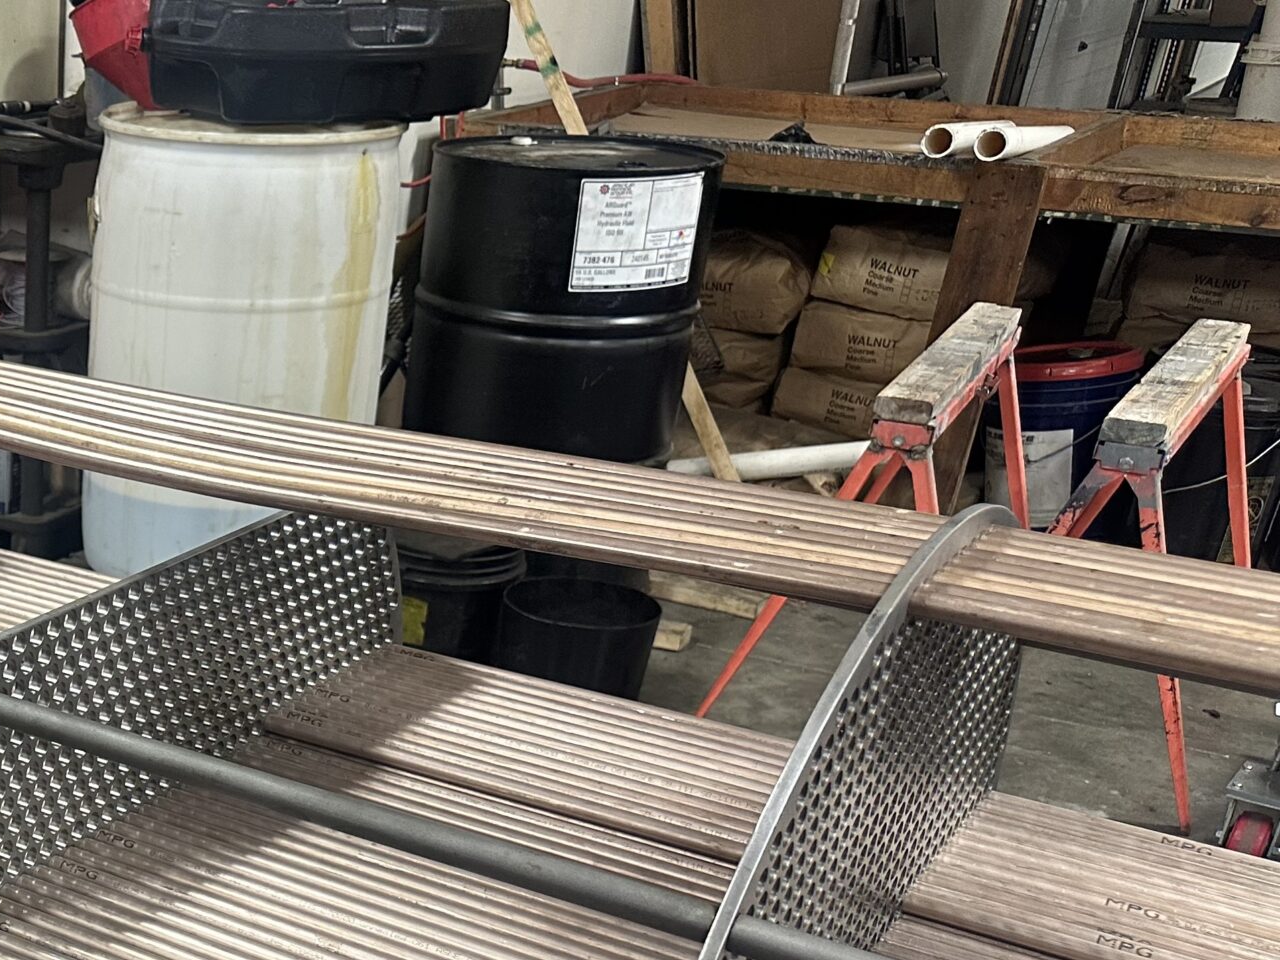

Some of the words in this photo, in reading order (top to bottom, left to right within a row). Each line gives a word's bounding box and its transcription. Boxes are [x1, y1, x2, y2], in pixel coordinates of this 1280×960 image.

[871, 258, 919, 278] WALNUT
[868, 270, 894, 283] Coarse
[1194, 273, 1251, 289] WALNUT
[862, 287, 878, 296] Fine
[865, 278, 894, 293] Medium
[1192, 286, 1223, 297] Coarse
[1188, 295, 1223, 306] Medium
[848, 334, 898, 348] WALNUT
[847, 346, 875, 355] Coarse
[846, 354, 877, 363] Medium
[844, 362, 861, 370] Fine
[831, 389, 874, 407] WALNU
[829, 400, 855, 412] Coarse
[824, 416, 840, 424] Fine
[826, 408, 857, 420] Medium
[314, 686, 351, 704] MPG
[286, 710, 323, 727] MPG
[266, 738, 303, 757] MPG
[1161, 834, 1213, 856] MPG
[1105, 896, 1160, 920] MPG
[1096, 933, 1153, 959] MPG
